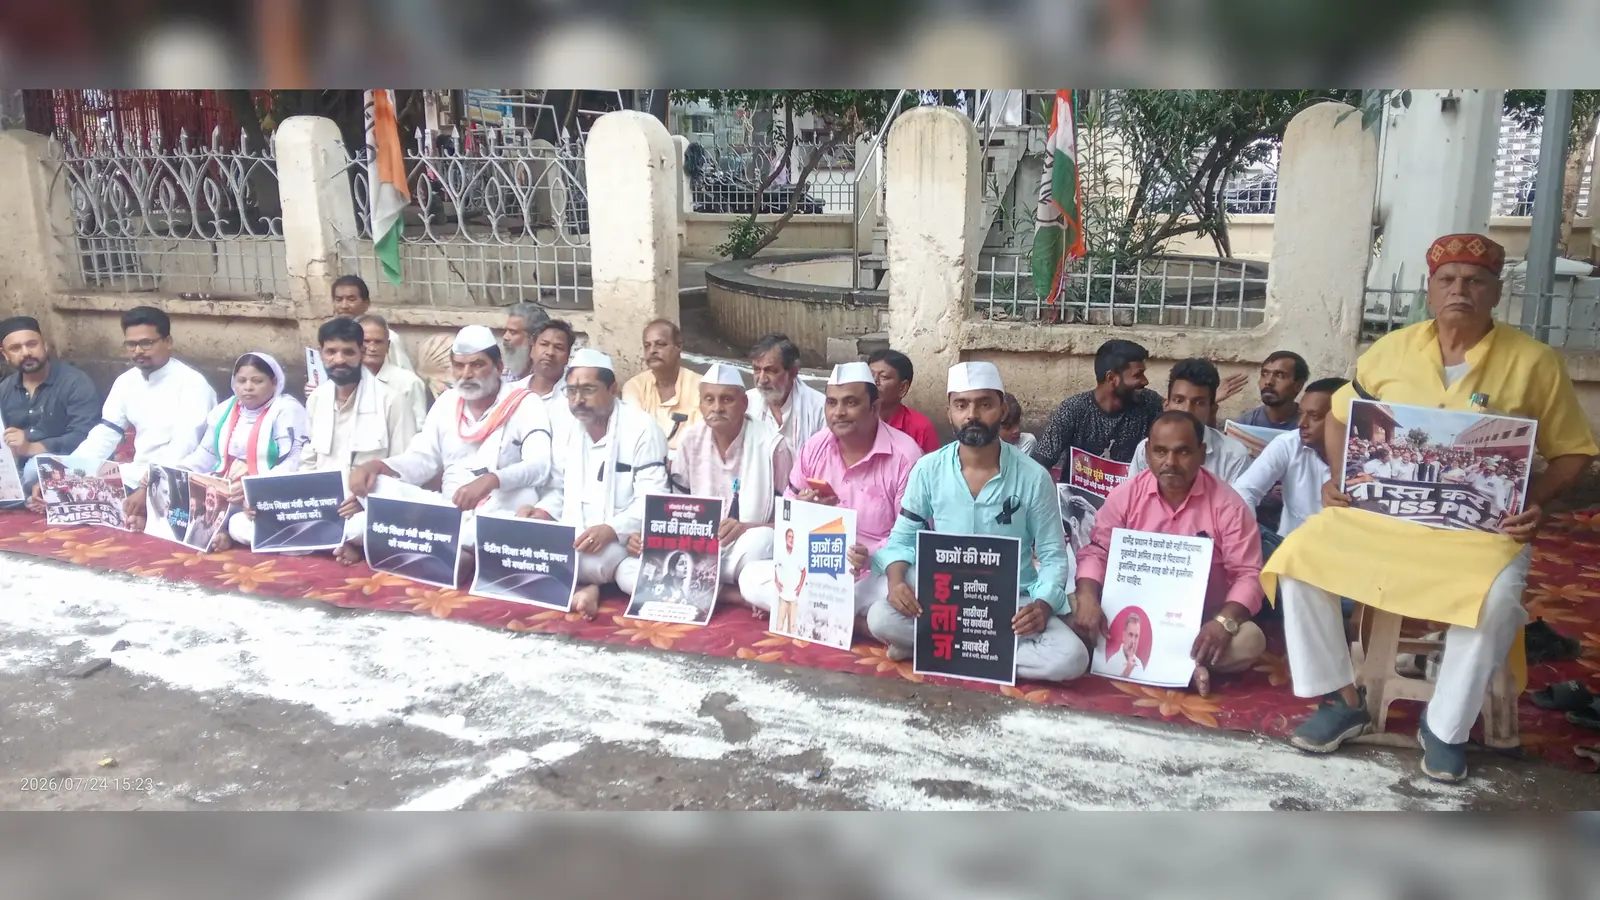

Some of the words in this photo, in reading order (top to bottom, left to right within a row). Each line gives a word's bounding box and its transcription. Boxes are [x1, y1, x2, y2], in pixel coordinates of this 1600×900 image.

[650, 520, 666, 533] कल
[667, 518, 678, 534] की
[811, 538, 830, 553] छात्रों
[831, 538, 843, 553] की
[811, 554, 843, 572] आवाज़
[936, 546, 961, 564] छात्रों
[963, 547, 978, 564] की
[980, 549, 1000, 566] मांग
[933, 573, 952, 602] इ
[963, 579, 988, 593] इस्तीफा
[930, 604, 958, 632] ला
[962, 618, 970, 627] पर
[932, 634, 954, 660] ज
